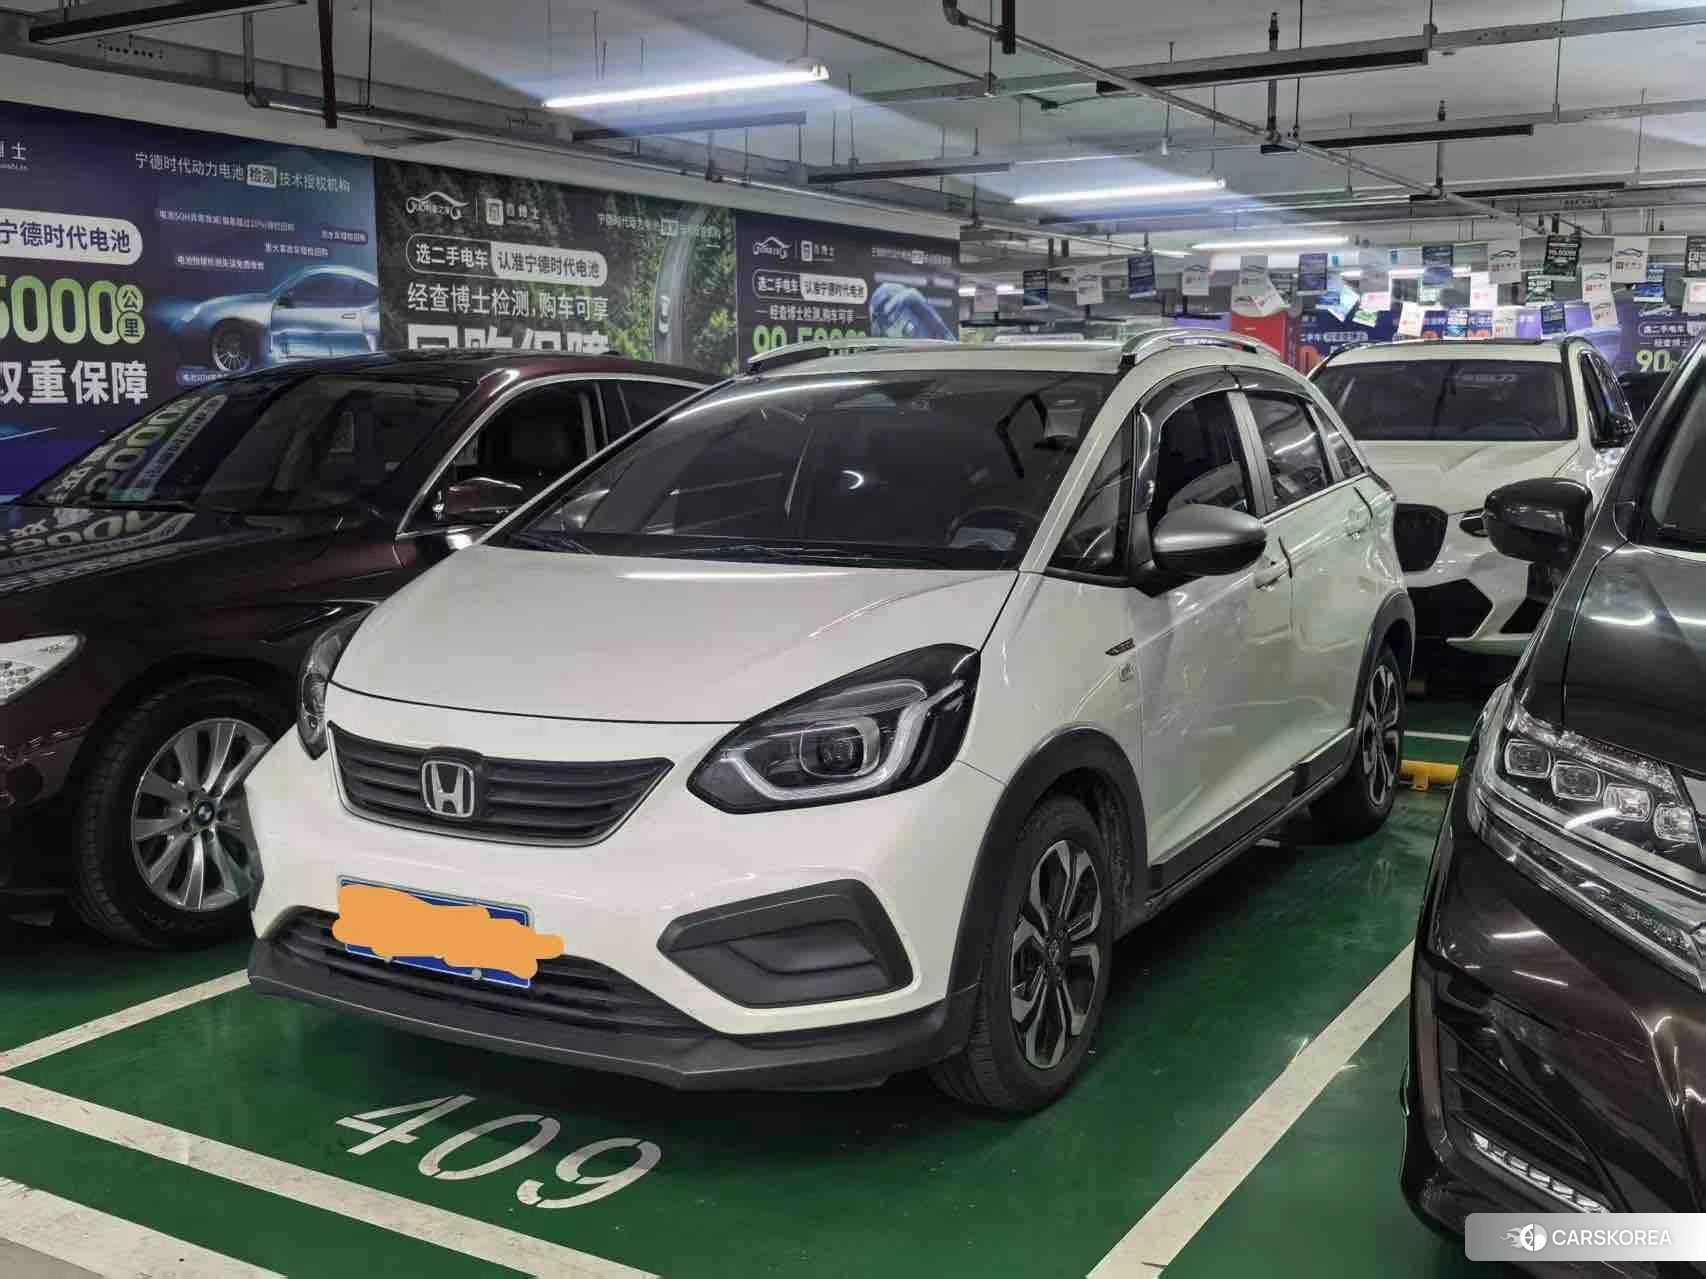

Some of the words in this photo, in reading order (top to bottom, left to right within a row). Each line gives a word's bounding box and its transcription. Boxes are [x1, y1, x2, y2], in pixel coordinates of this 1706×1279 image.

[0, 220, 131, 254] 宁德时代电池
[415, 243, 489, 271] 选二手电车
[497, 250, 600, 280] 认准宁德时代电池
[0, 274, 120, 346] 000
[1636, 349, 1671, 373] 90
[336, 1093, 662, 1210] 409
